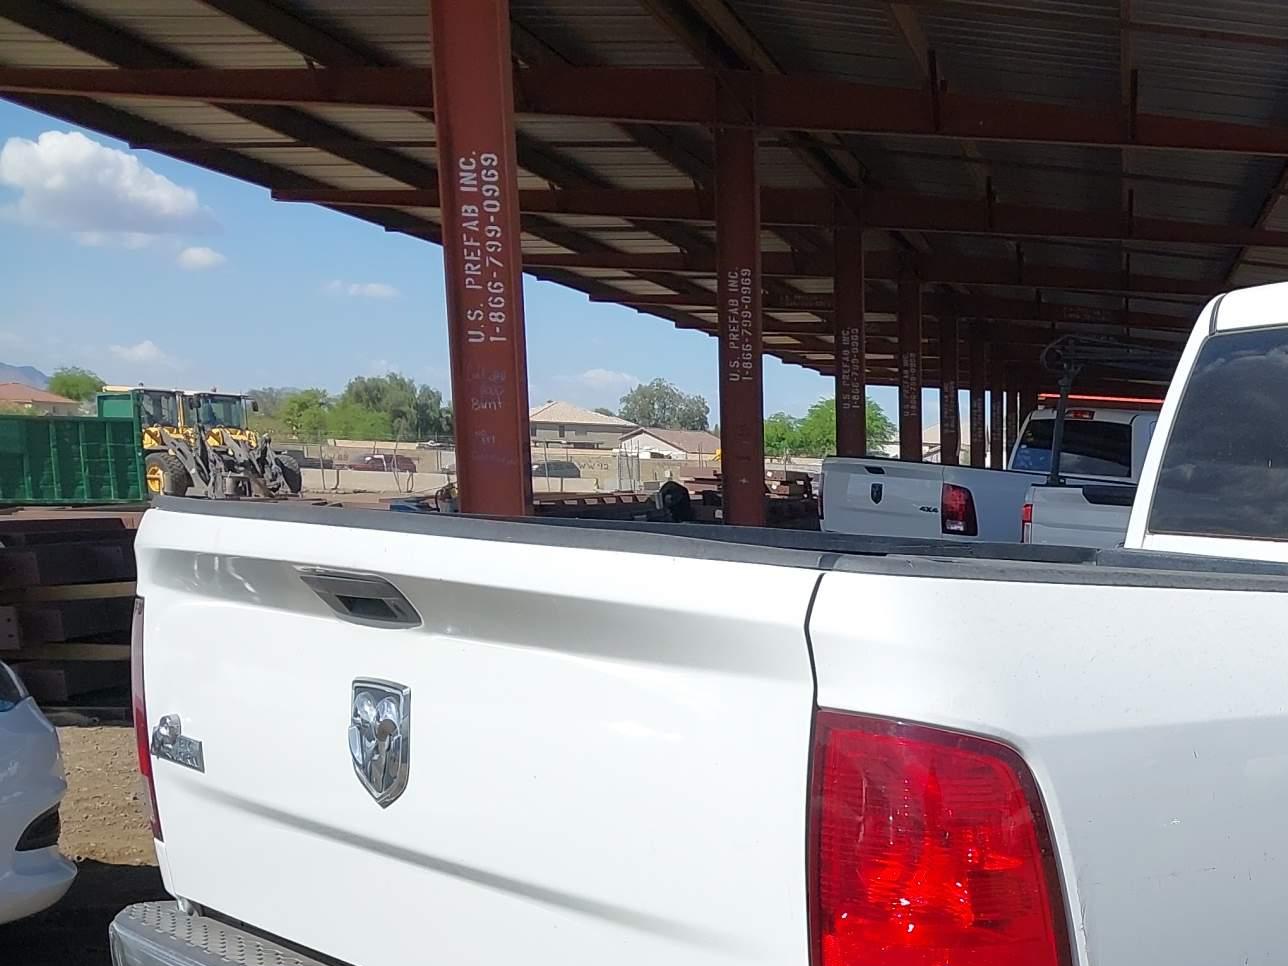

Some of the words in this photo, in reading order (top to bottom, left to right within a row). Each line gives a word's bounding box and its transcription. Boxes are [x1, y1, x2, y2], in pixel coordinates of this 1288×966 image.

[458, 151, 479, 192] INC.
[461, 203, 483, 289] PREFAB
[480, 153, 507, 343] 1-866-799-0969
[727, 267, 739, 292] INC.
[466, 302, 486, 343] U.S.
[728, 298, 739, 349] PREFAB
